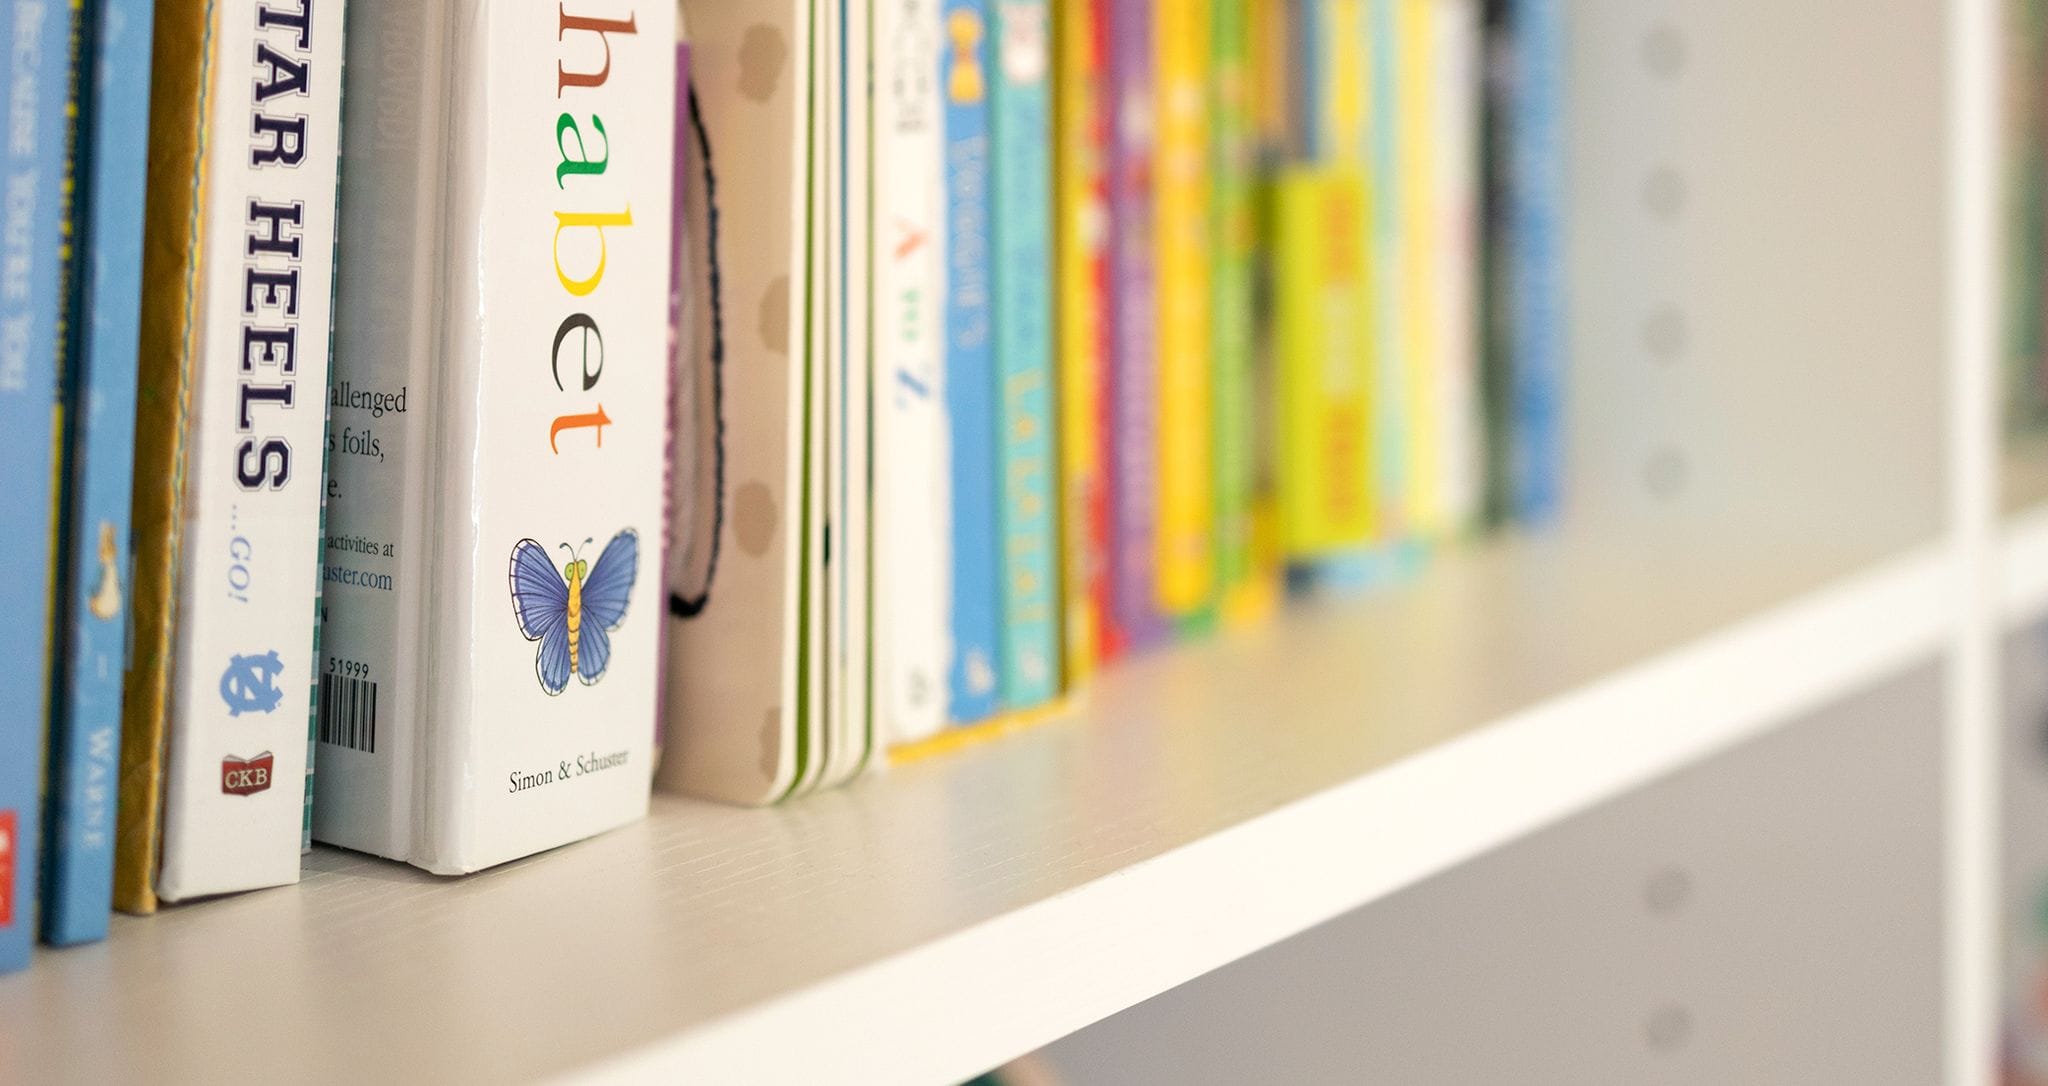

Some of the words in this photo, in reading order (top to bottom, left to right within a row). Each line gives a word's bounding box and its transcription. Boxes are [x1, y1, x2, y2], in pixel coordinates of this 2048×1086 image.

[550, 0, 638, 455] habet
[233, 196, 304, 492] HEELS
[331, 381, 407, 418] allenged
[342, 426, 385, 463] foils,
[327, 535, 380, 556] activities
[382, 542, 394, 557] at
[322, 565, 393, 591] uster.com
[330, 657, 369, 679] 51999
[224, 767, 269, 790] CKB
[509, 770, 553, 793] Simon
[558, 760, 571, 780] &
[576, 751, 629, 776] Schuster
